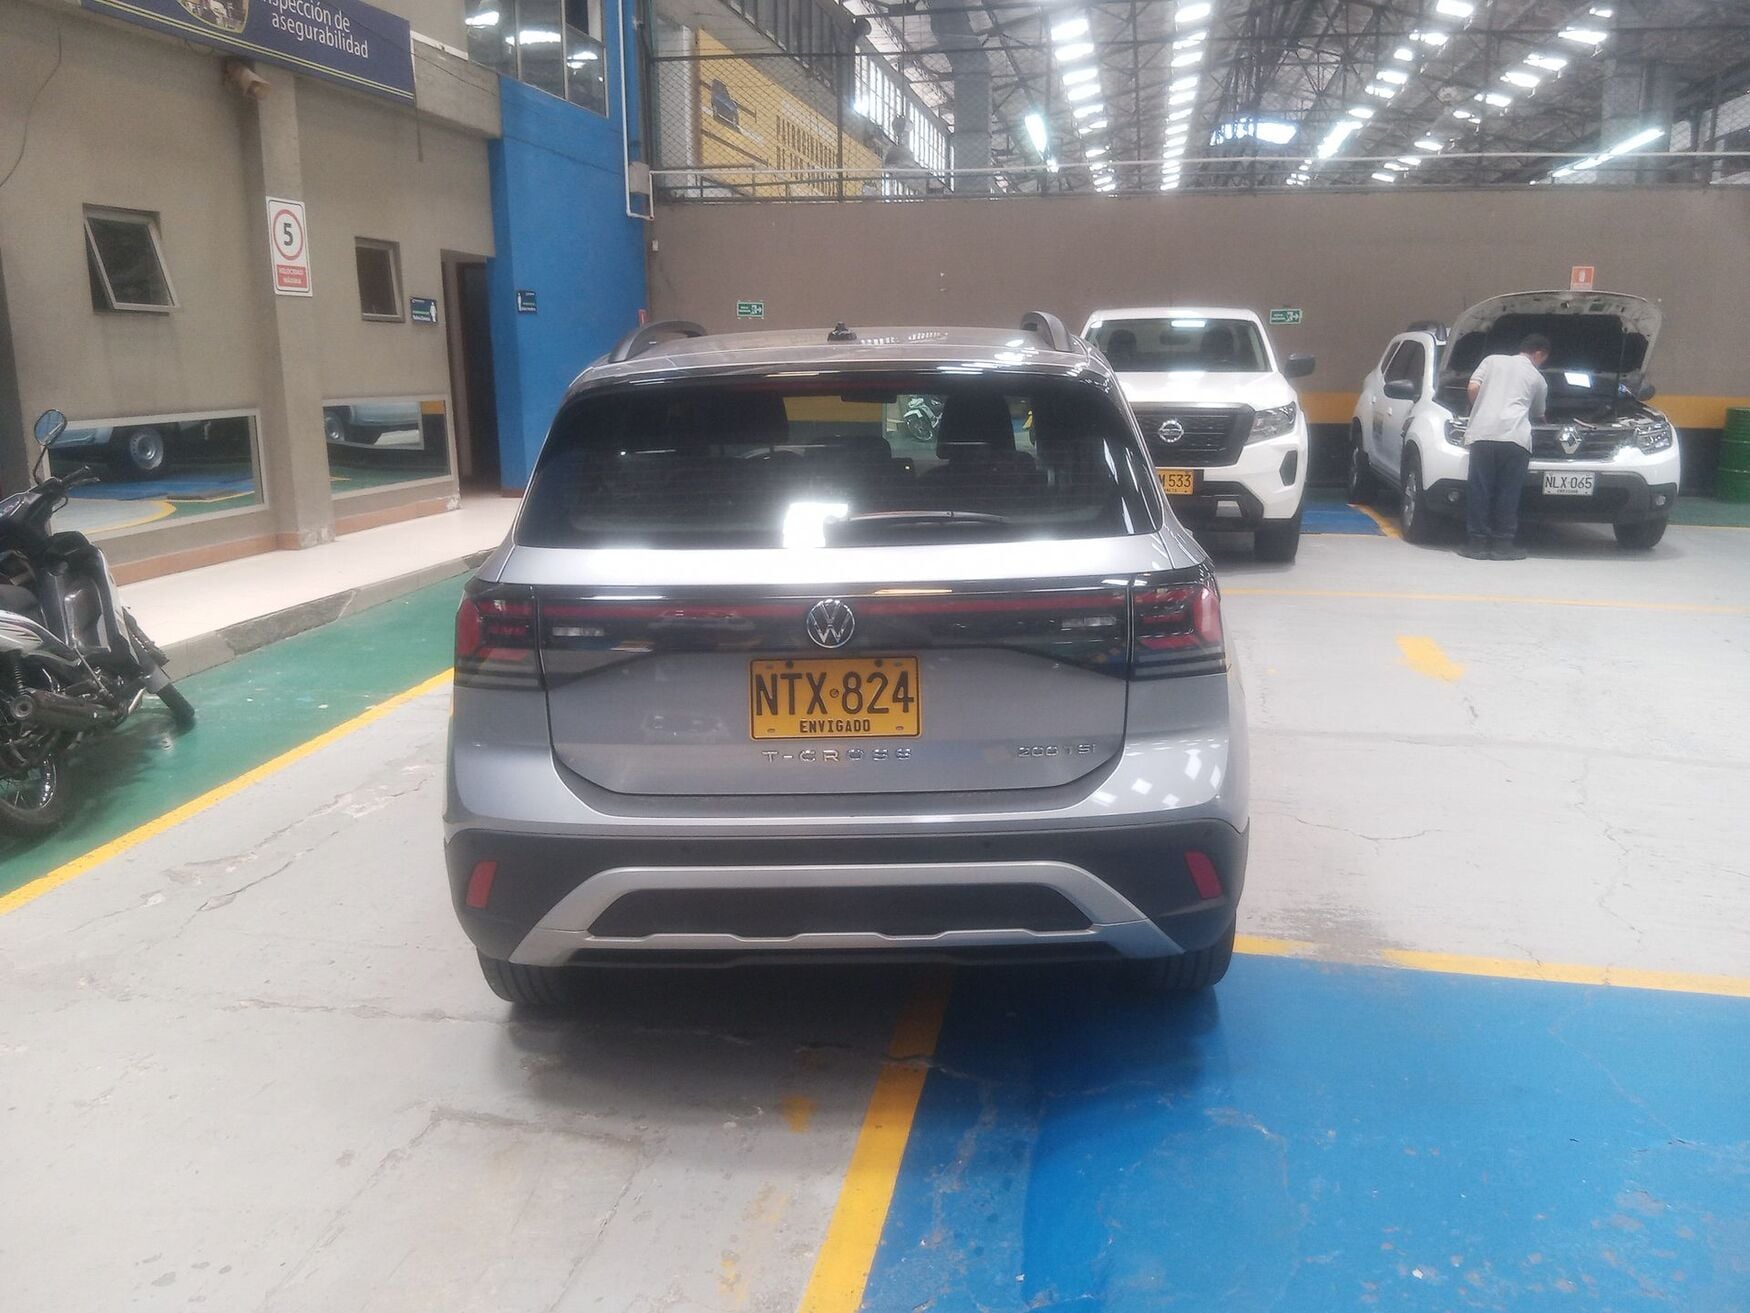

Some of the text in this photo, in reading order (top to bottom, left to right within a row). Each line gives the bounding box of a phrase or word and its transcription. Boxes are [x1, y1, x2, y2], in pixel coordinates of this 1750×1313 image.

[334, 10, 351, 33] de
[271, 12, 369, 59] asegurabilidad
[283, 222, 294, 247] 5
[1168, 474, 1192, 488] 533
[1545, 476, 1593, 489] NLX 065
[755, 671, 915, 716] NTX 824
[799, 719, 871, 734] ENVIGADO
[761, 748, 913, 763] T-CROSS
